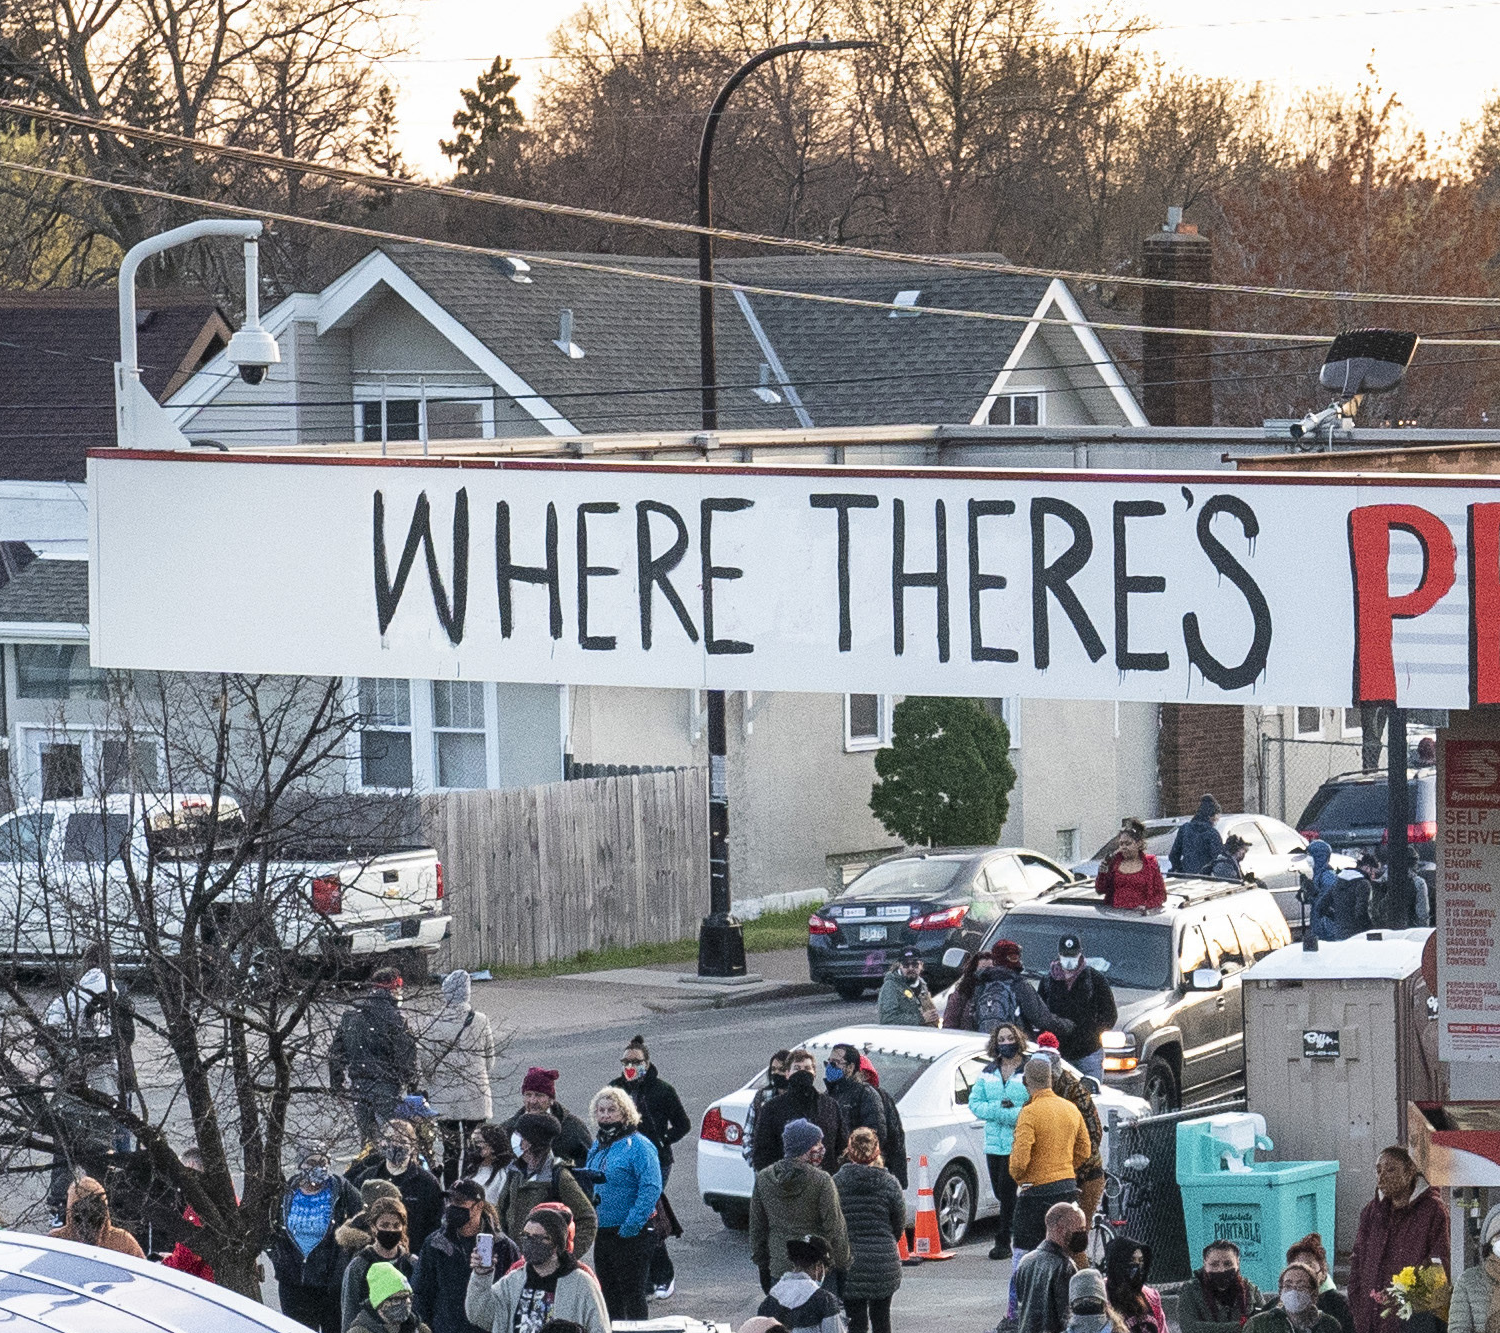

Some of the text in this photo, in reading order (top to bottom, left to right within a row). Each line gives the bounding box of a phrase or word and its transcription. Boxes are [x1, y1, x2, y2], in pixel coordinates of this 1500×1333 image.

[374, 487, 754, 655] WHERE
[810, 487, 1272, 692] THERE'S
[1444, 810, 1487, 825] SELF
[1444, 829, 1500, 845] SERVE
[1443, 847, 1472, 859] STOP
[1443, 859, 1483, 870] ENGINE
[1444, 872, 1460, 883] NO
[1443, 883, 1492, 894] SMOKING
[1213, 1222, 1262, 1240] PORTABLE
